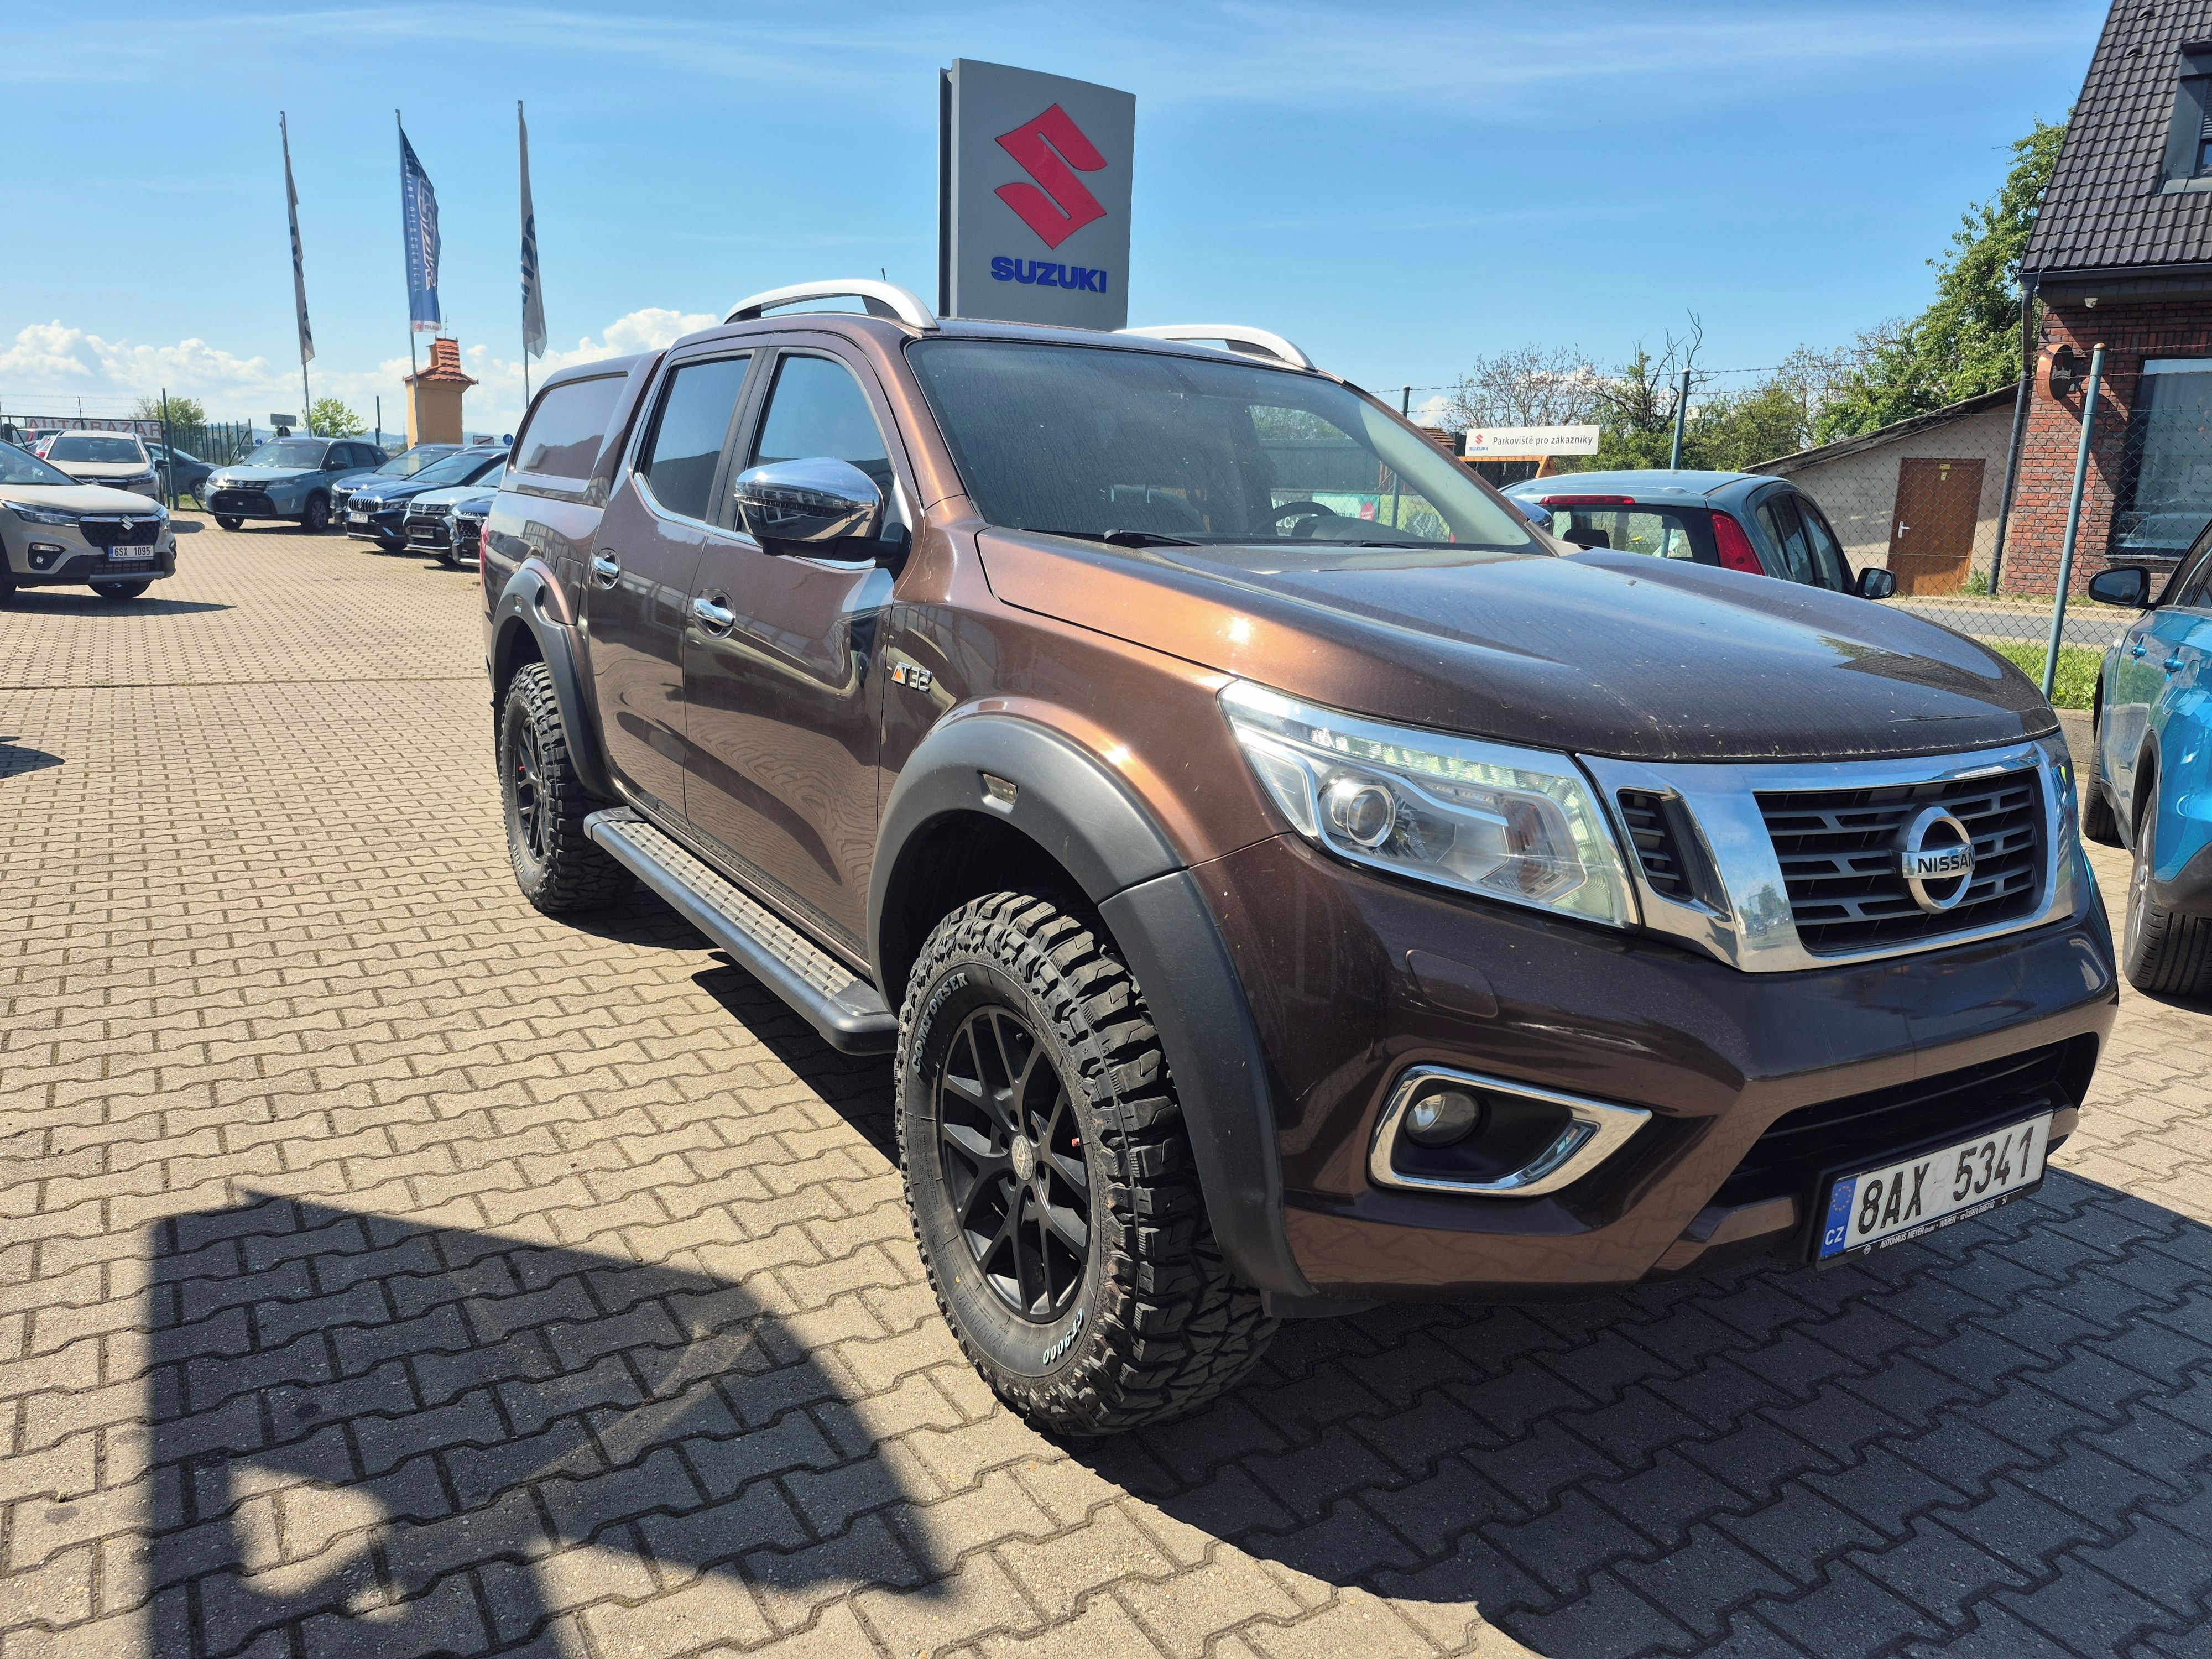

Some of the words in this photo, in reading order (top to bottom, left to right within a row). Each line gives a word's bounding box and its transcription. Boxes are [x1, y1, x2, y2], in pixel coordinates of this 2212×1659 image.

[990, 256, 1107, 294] SUZUKI
[1493, 435, 1533, 445] Parkoviště
[1535, 437, 1548, 446] pro
[1551, 434, 1593, 446] zákazníky
[114, 547, 128, 556] 6SX
[133, 546, 150, 556] 1095
[1917, 850, 1975, 874] NISSAN
[912, 972, 968, 1073] COMFORSER
[1857, 1162, 1930, 1235] 8AX
[1952, 1126, 2035, 1202] 5341
[1824, 1226, 1845, 1246] CZ
[1879, 1233, 1907, 1249] AUTOHAUS
[1907, 1227, 1924, 1241] MEYER
[1939, 1215, 1957, 1229] WAREN
[1042, 1307, 1084, 1366] CF9000
